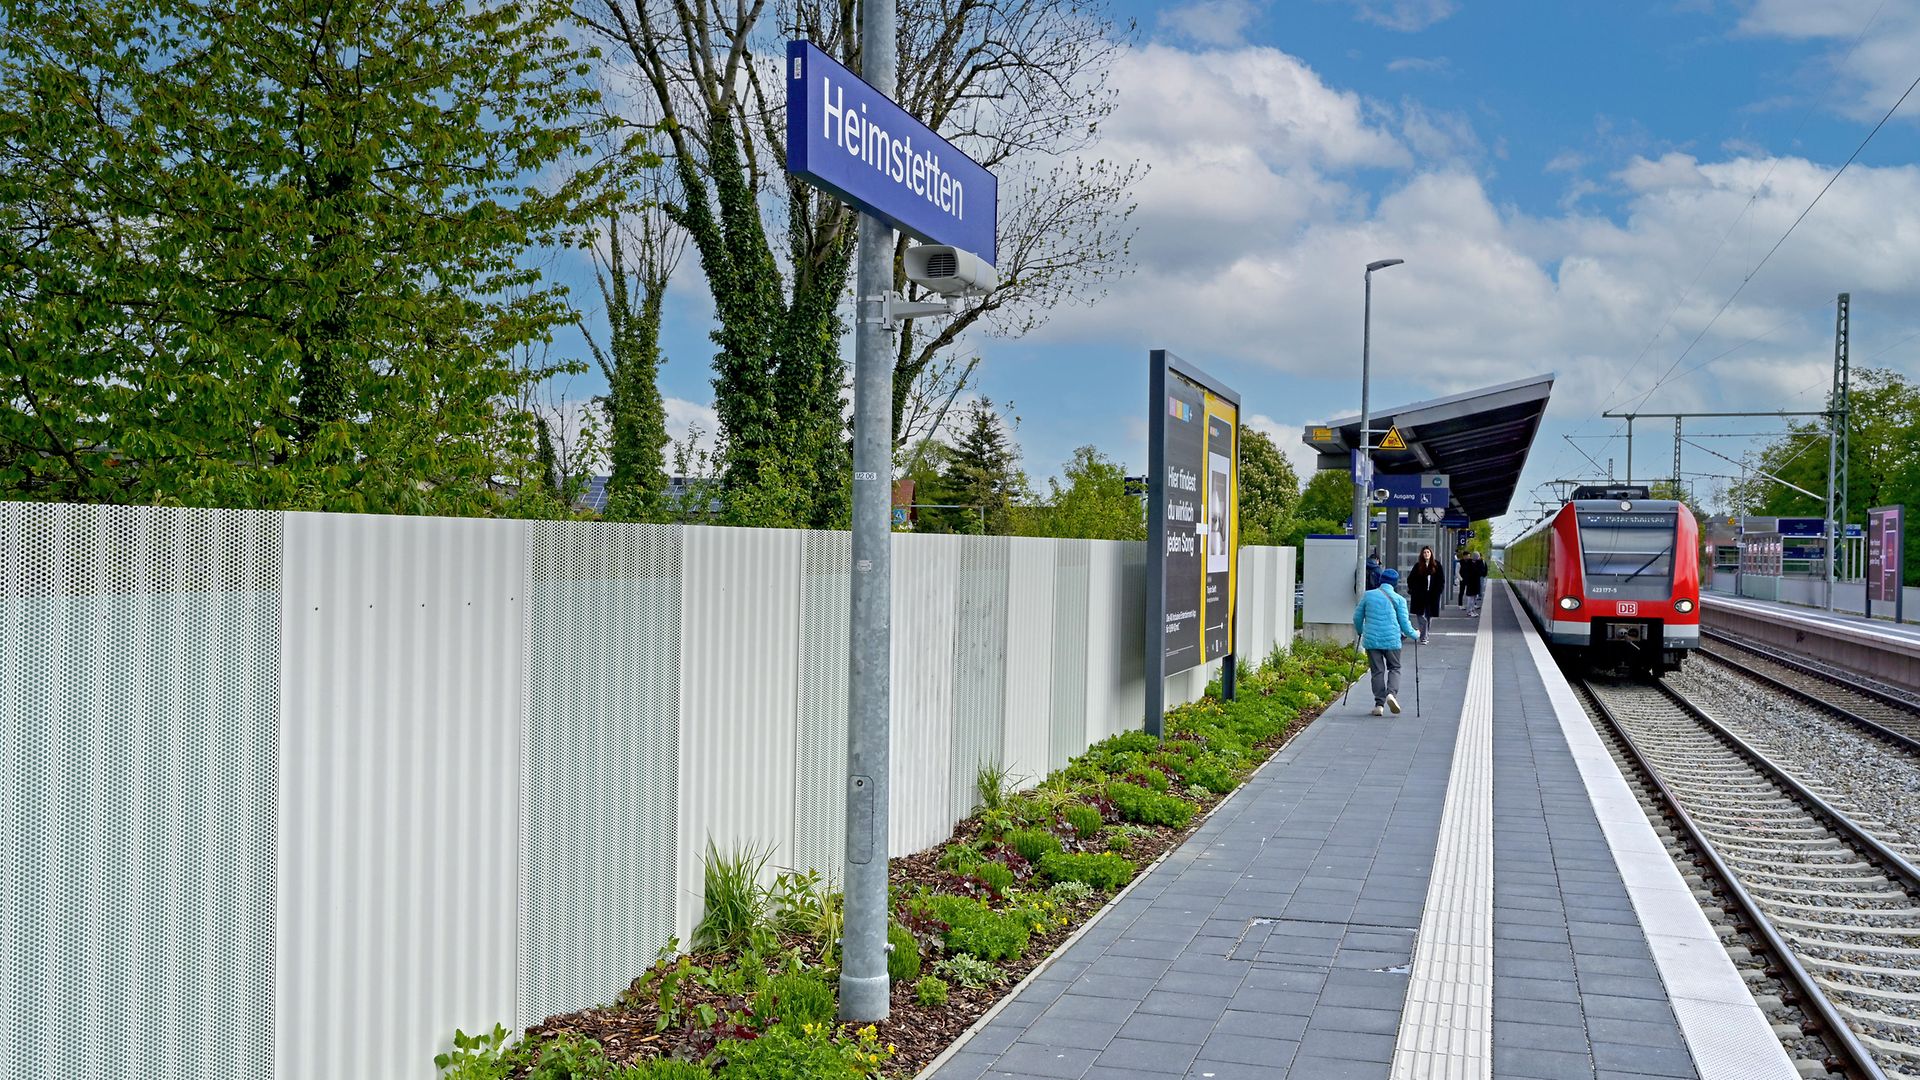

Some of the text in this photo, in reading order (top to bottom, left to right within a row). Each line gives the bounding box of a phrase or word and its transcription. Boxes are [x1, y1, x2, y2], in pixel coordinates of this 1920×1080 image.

[823, 77, 963, 221] Heimstetten
[1168, 465, 1197, 491] Hier findest
[1167, 499, 1194, 521] du wirklich
[1166, 530, 1181, 557] jeden
[1619, 604, 1635, 613] DB
